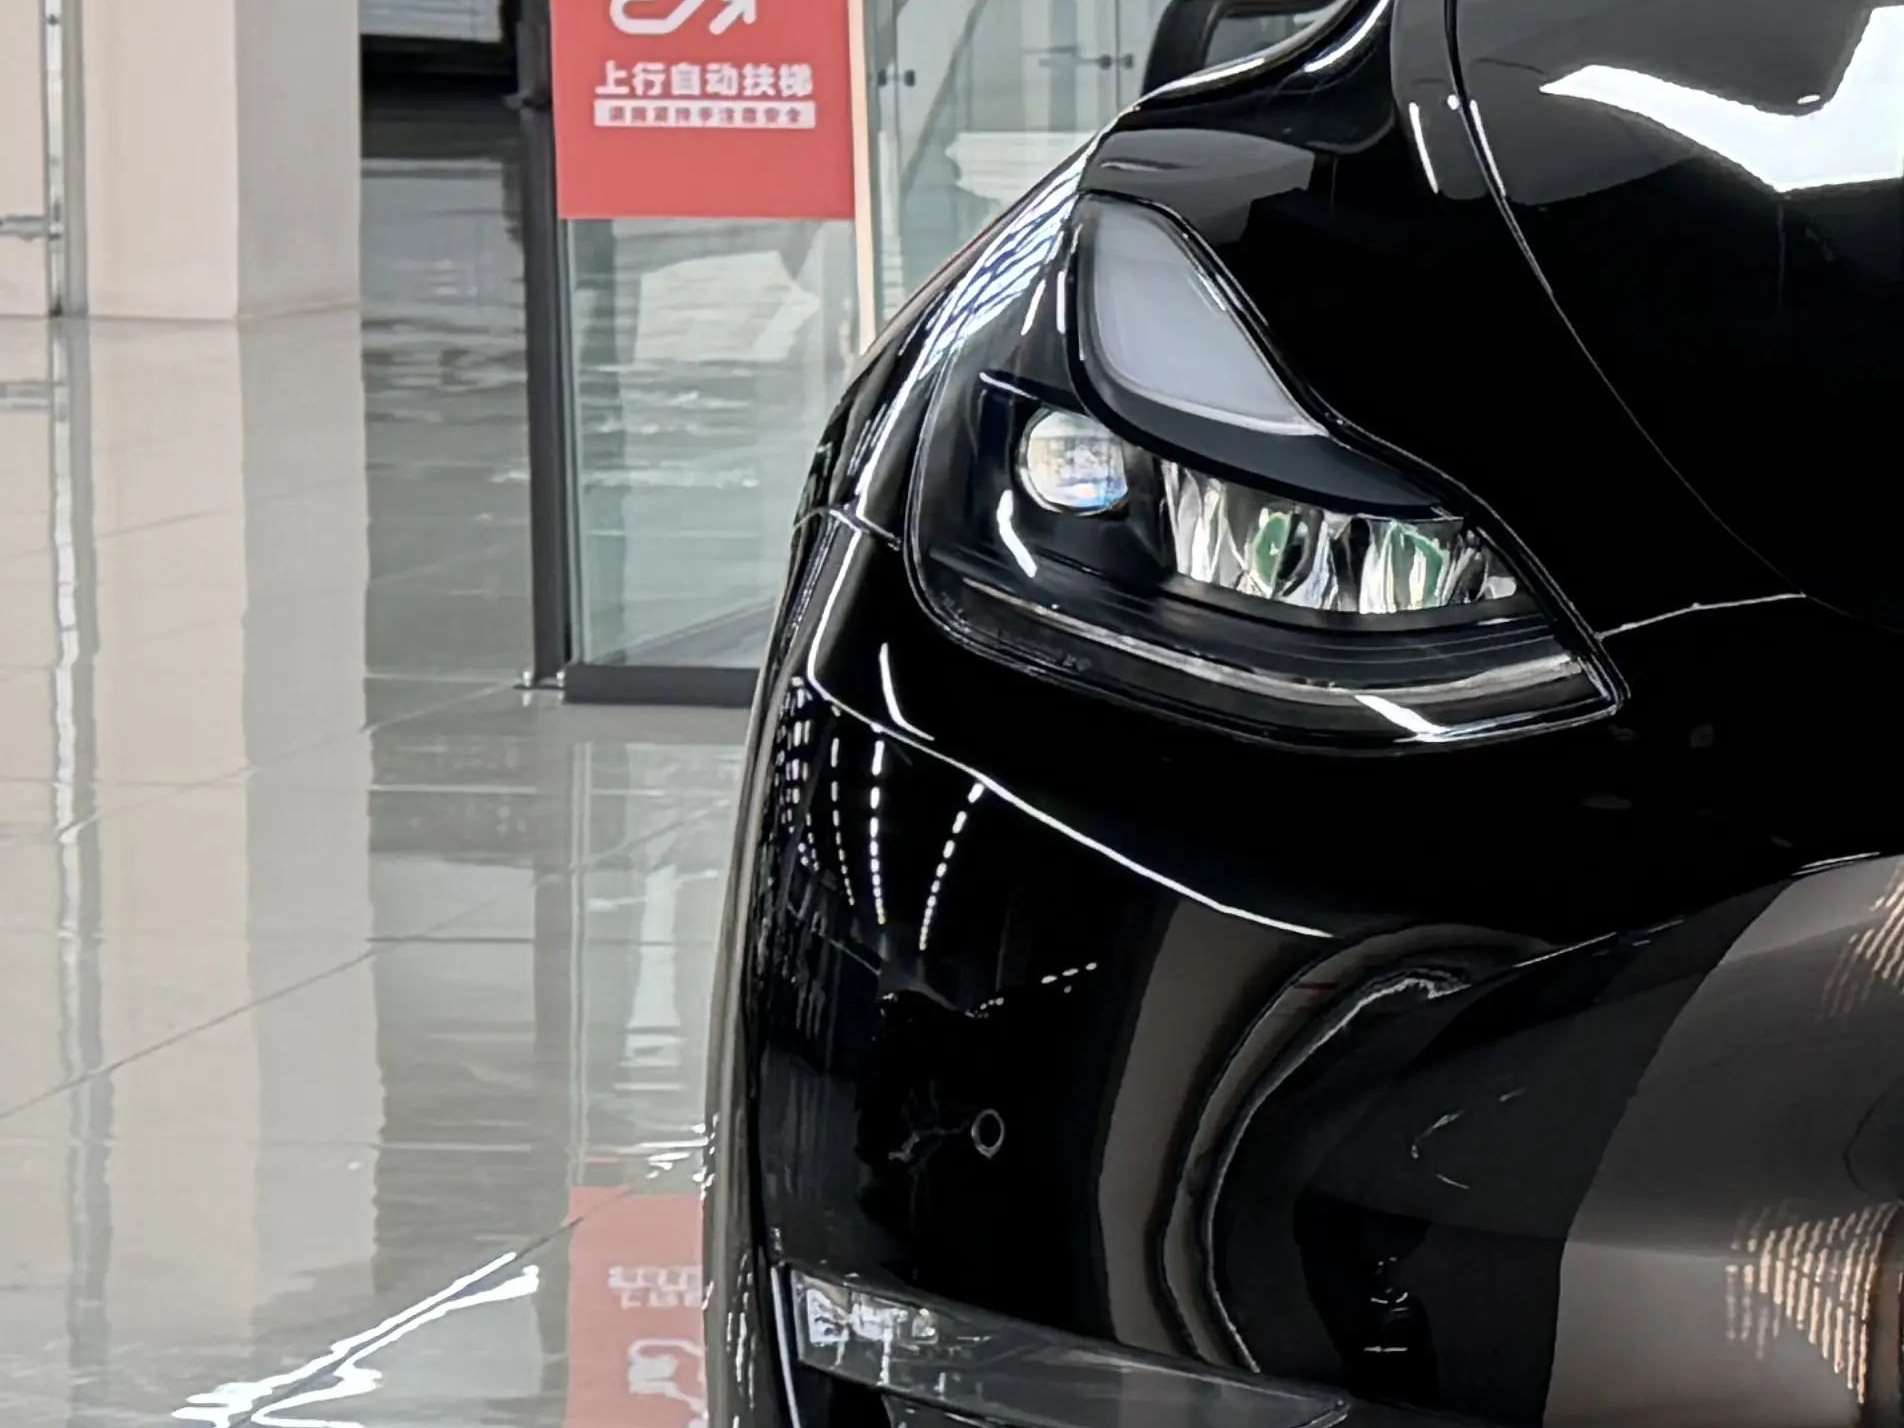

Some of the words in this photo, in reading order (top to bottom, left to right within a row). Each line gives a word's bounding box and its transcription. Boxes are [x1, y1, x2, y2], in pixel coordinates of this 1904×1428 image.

[595, 59, 813, 96] 上行自动扶梯
